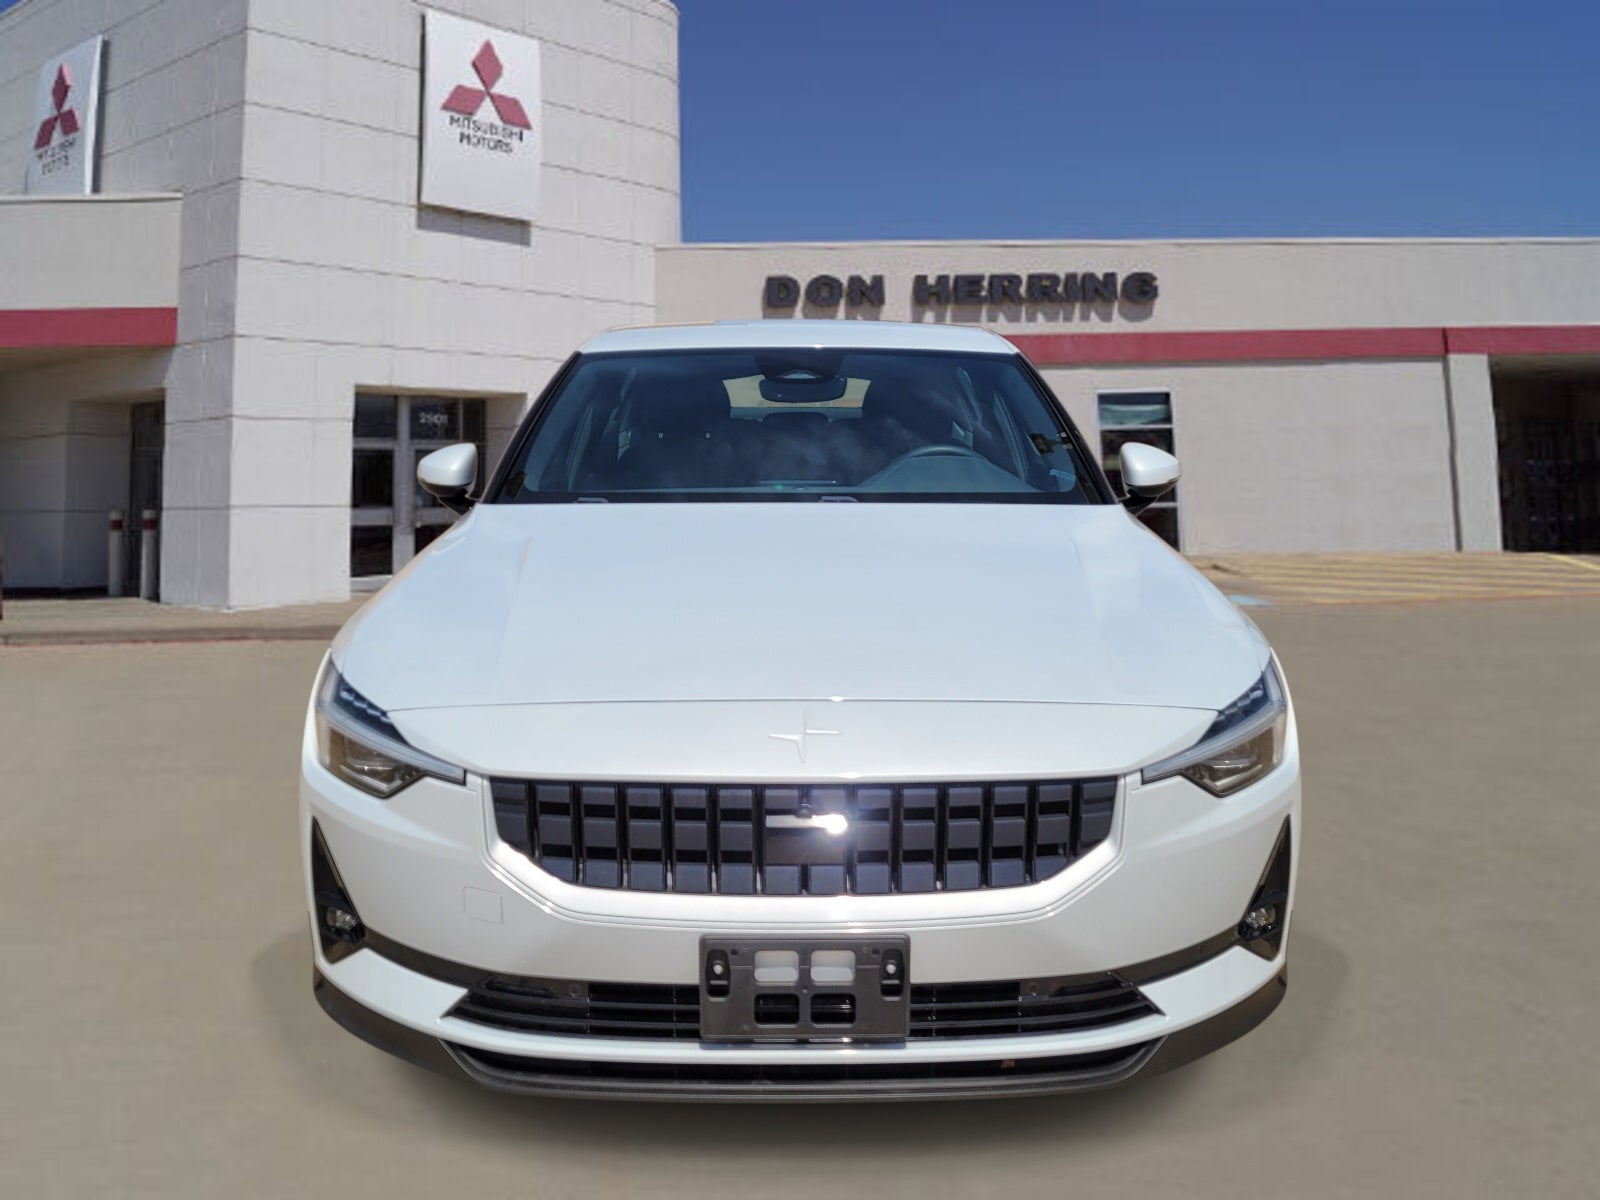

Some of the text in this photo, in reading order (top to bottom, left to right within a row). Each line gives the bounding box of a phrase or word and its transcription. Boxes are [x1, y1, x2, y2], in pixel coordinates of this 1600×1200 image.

[459, 132, 513, 154] MOTORS
[765, 271, 1160, 307] DON HERRING
